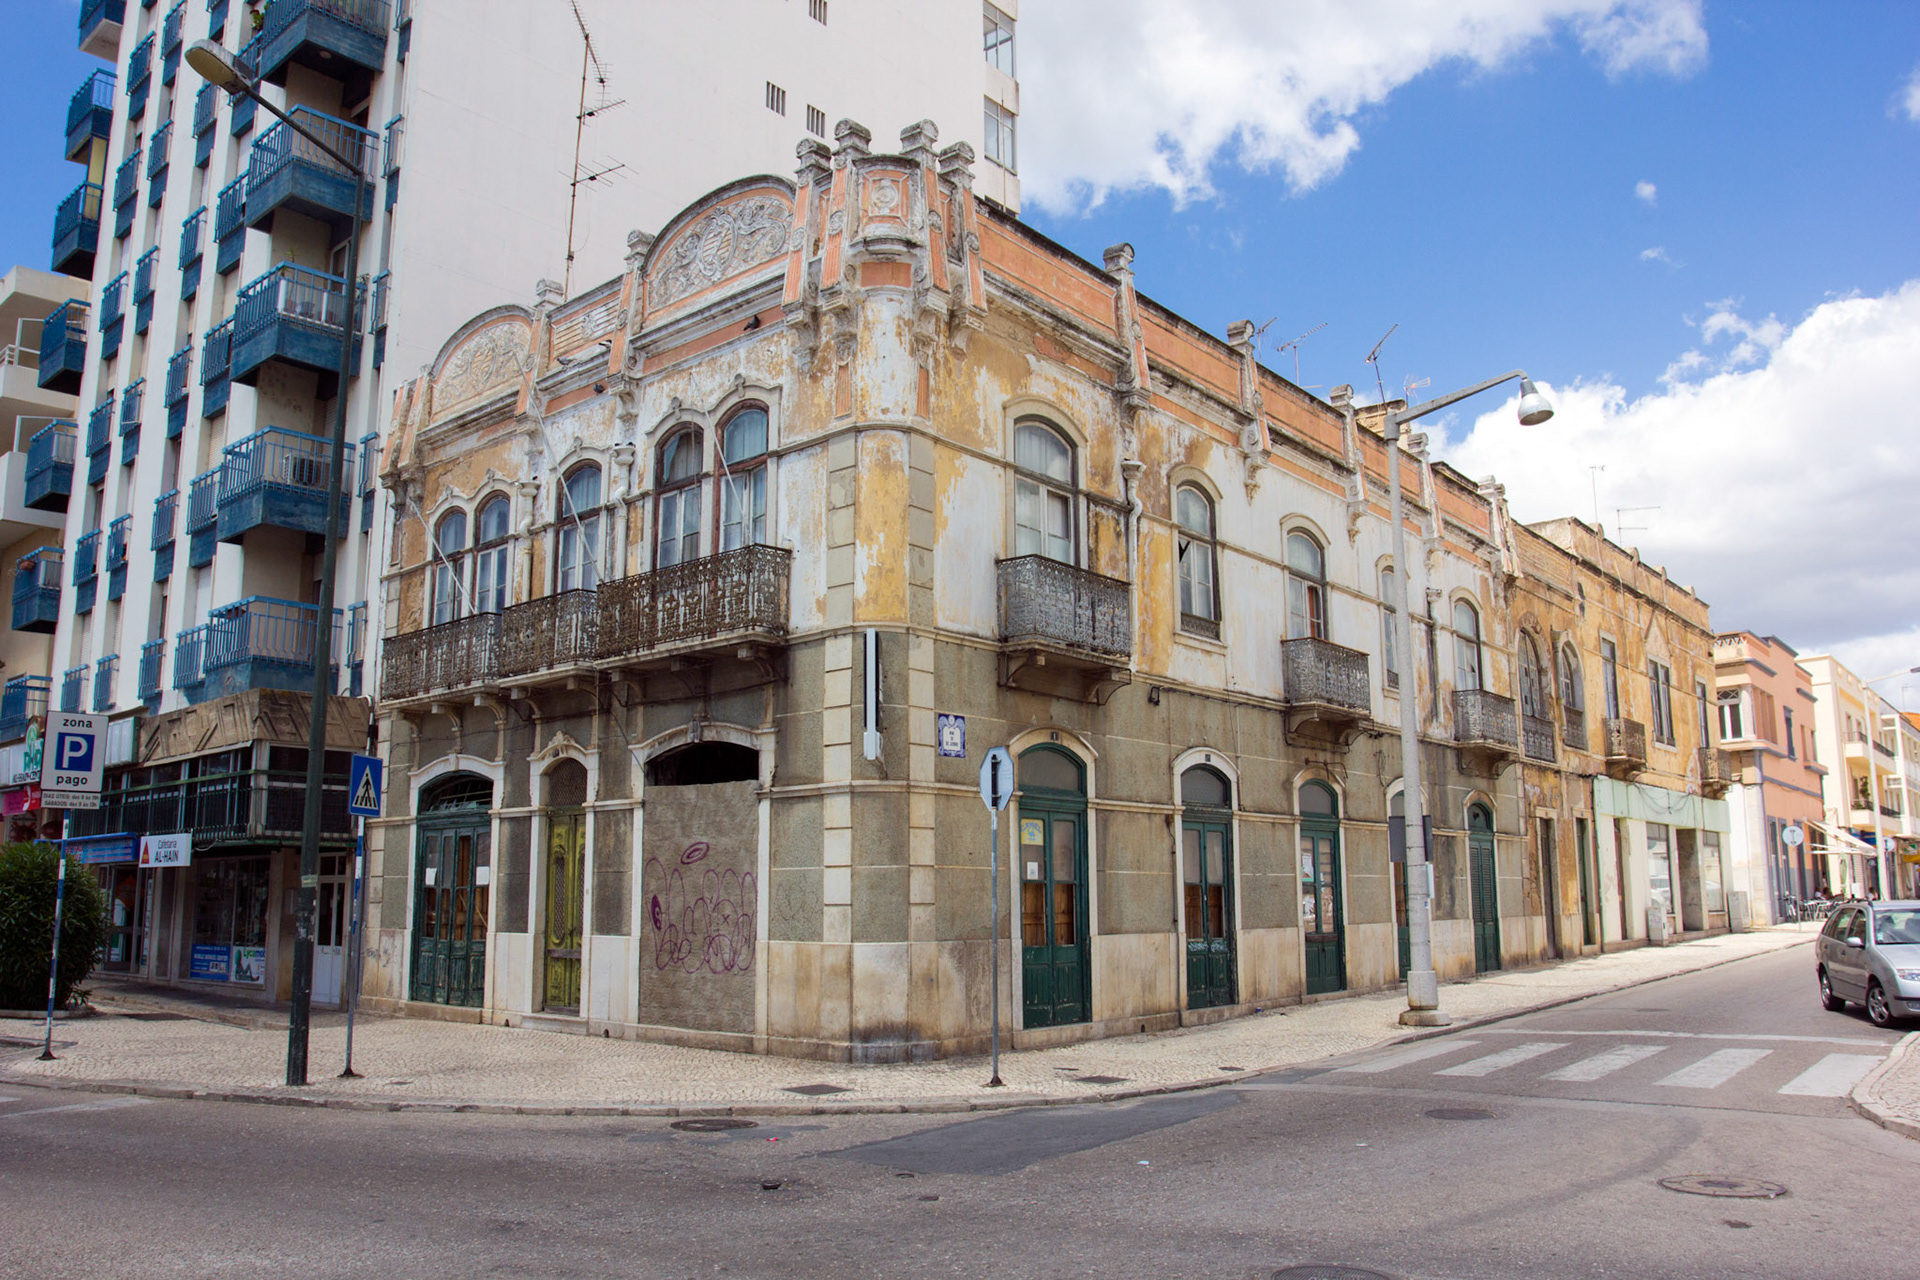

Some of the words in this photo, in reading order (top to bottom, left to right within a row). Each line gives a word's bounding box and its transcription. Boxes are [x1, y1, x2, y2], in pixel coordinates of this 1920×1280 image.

[63, 718, 93, 729] zona
[62, 735, 88, 769] P
[56, 776, 88, 787] pago
[154, 850, 179, 863] AL-HAIN
